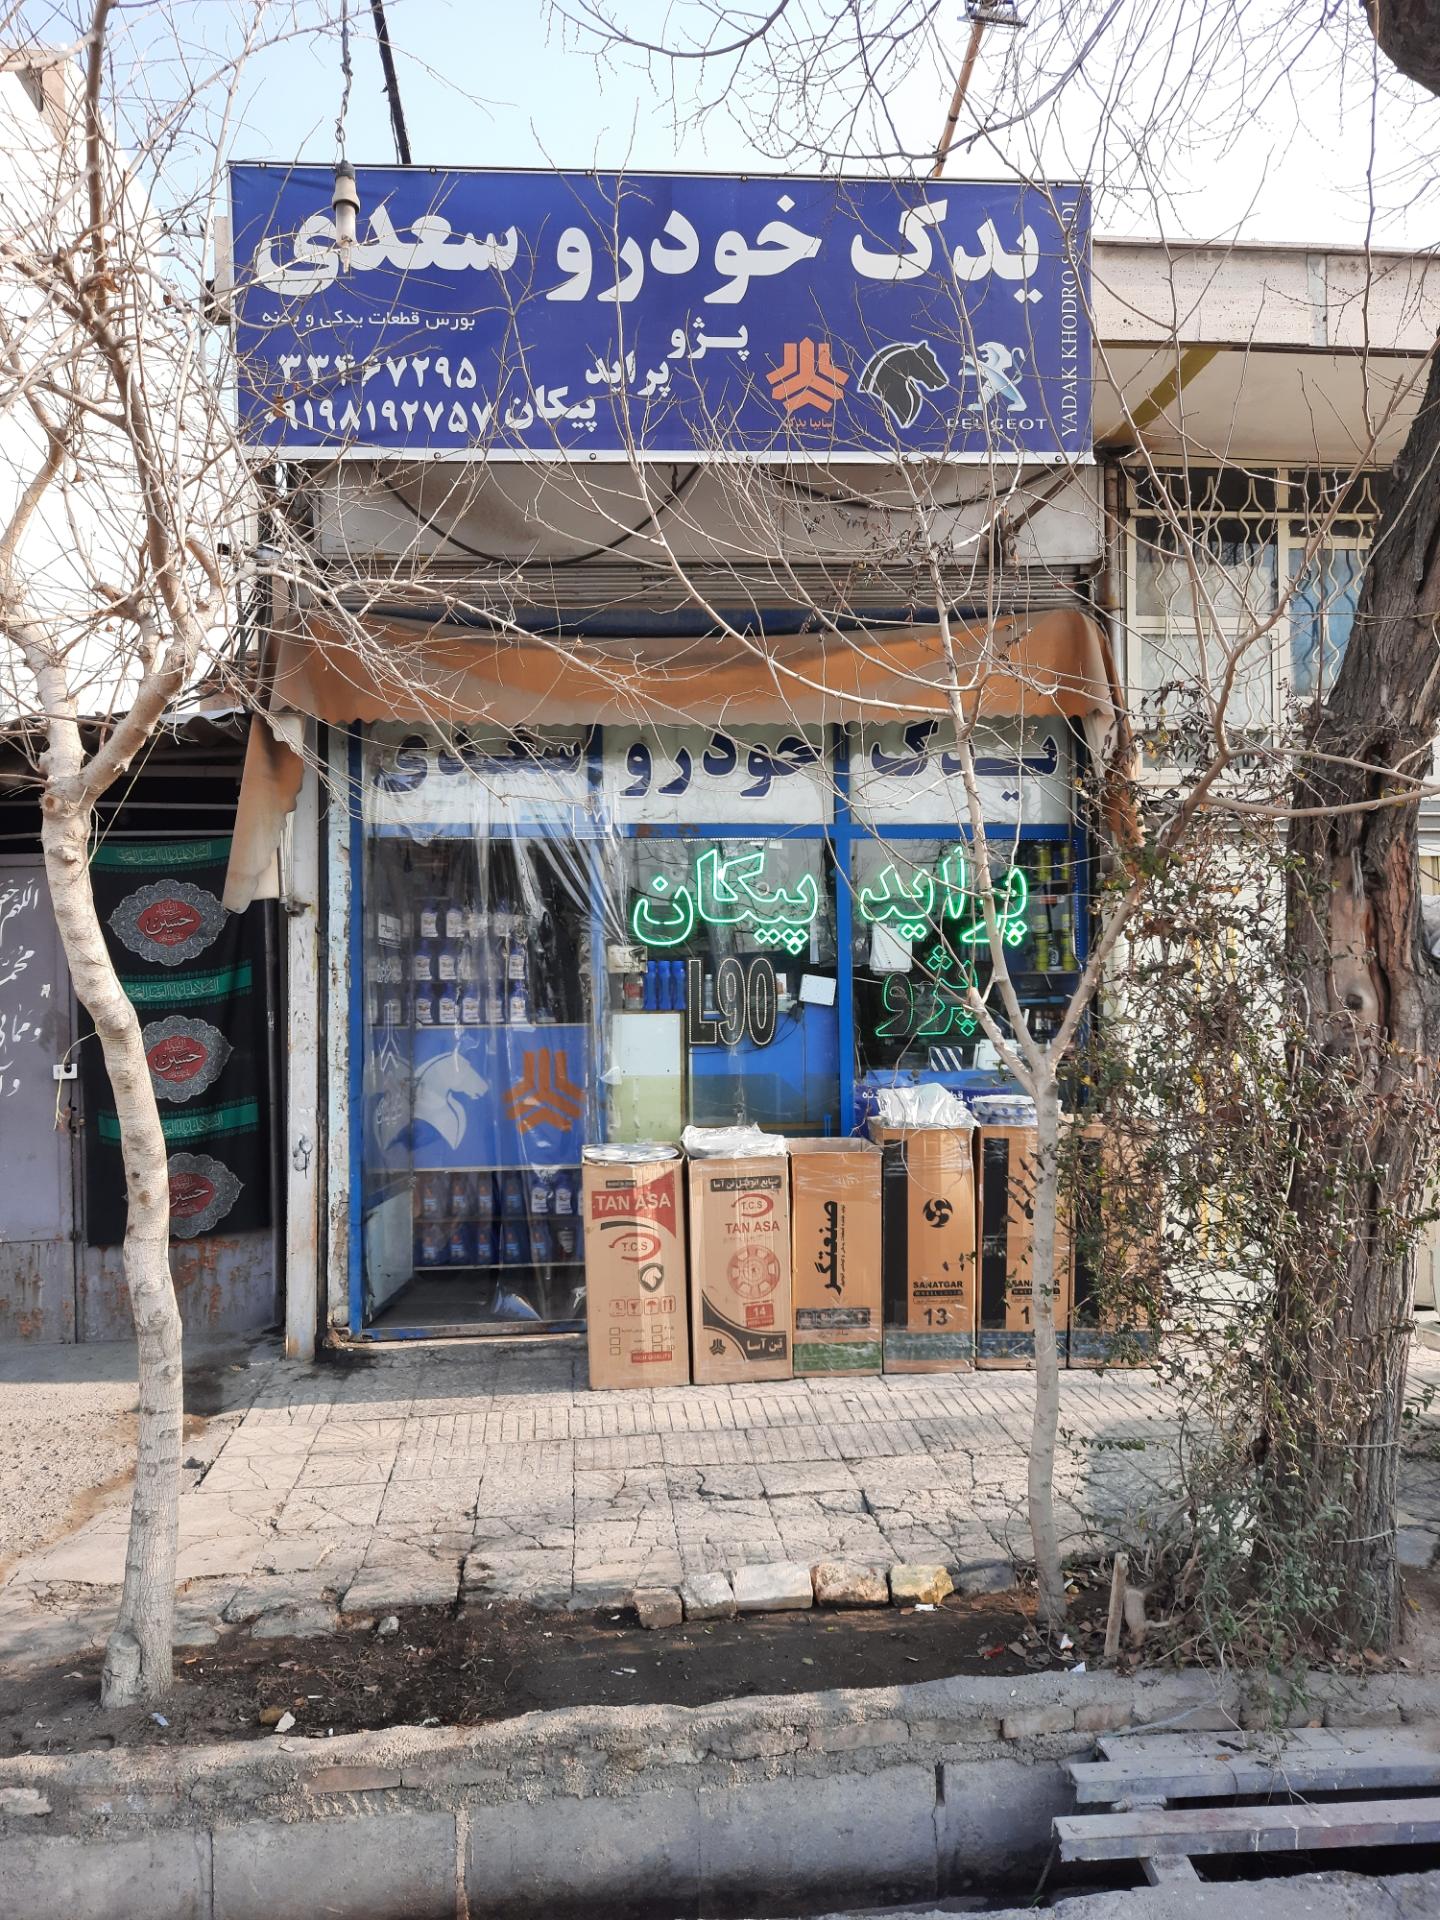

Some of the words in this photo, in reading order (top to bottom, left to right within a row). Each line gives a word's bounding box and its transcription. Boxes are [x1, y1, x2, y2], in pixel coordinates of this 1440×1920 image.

[255, 204, 519, 296] سعدی
[545, 194, 823, 303] خودرو
[850, 199, 1043, 304] یدک
[305, 314, 314, 327] و
[320, 310, 364, 328] یدکی
[368, 311, 421, 326] قطعات
[426, 315, 476, 331] بورس
[1060, 271, 1078, 359] KHODRO
[667, 316, 750, 362] پژو
[586, 351, 671, 398] پراید
[505, 385, 598, 434] پیکان
[1060, 366, 1078, 437] YADAK
[633, 847, 820, 956] پیکان
[860, 846, 1028, 947] پراید
[688, 957, 777, 1046] L90
[595, 1195, 630, 1211] TAN
[634, 1192, 671, 1210] ASA
[741, 1200, 763, 1210] T.C.S
[725, 1222, 750, 1234] TAN
[754, 1220, 780, 1233] ASA
[622, 1241, 648, 1252] T.C.S
[814, 1200, 842, 1296] صنعتگر
[913, 1280, 963, 1289] SANATGAR
[752, 1305, 766, 1317] 14
[923, 1307, 949, 1327] 13
[769, 1338, 783, 1353] تن
